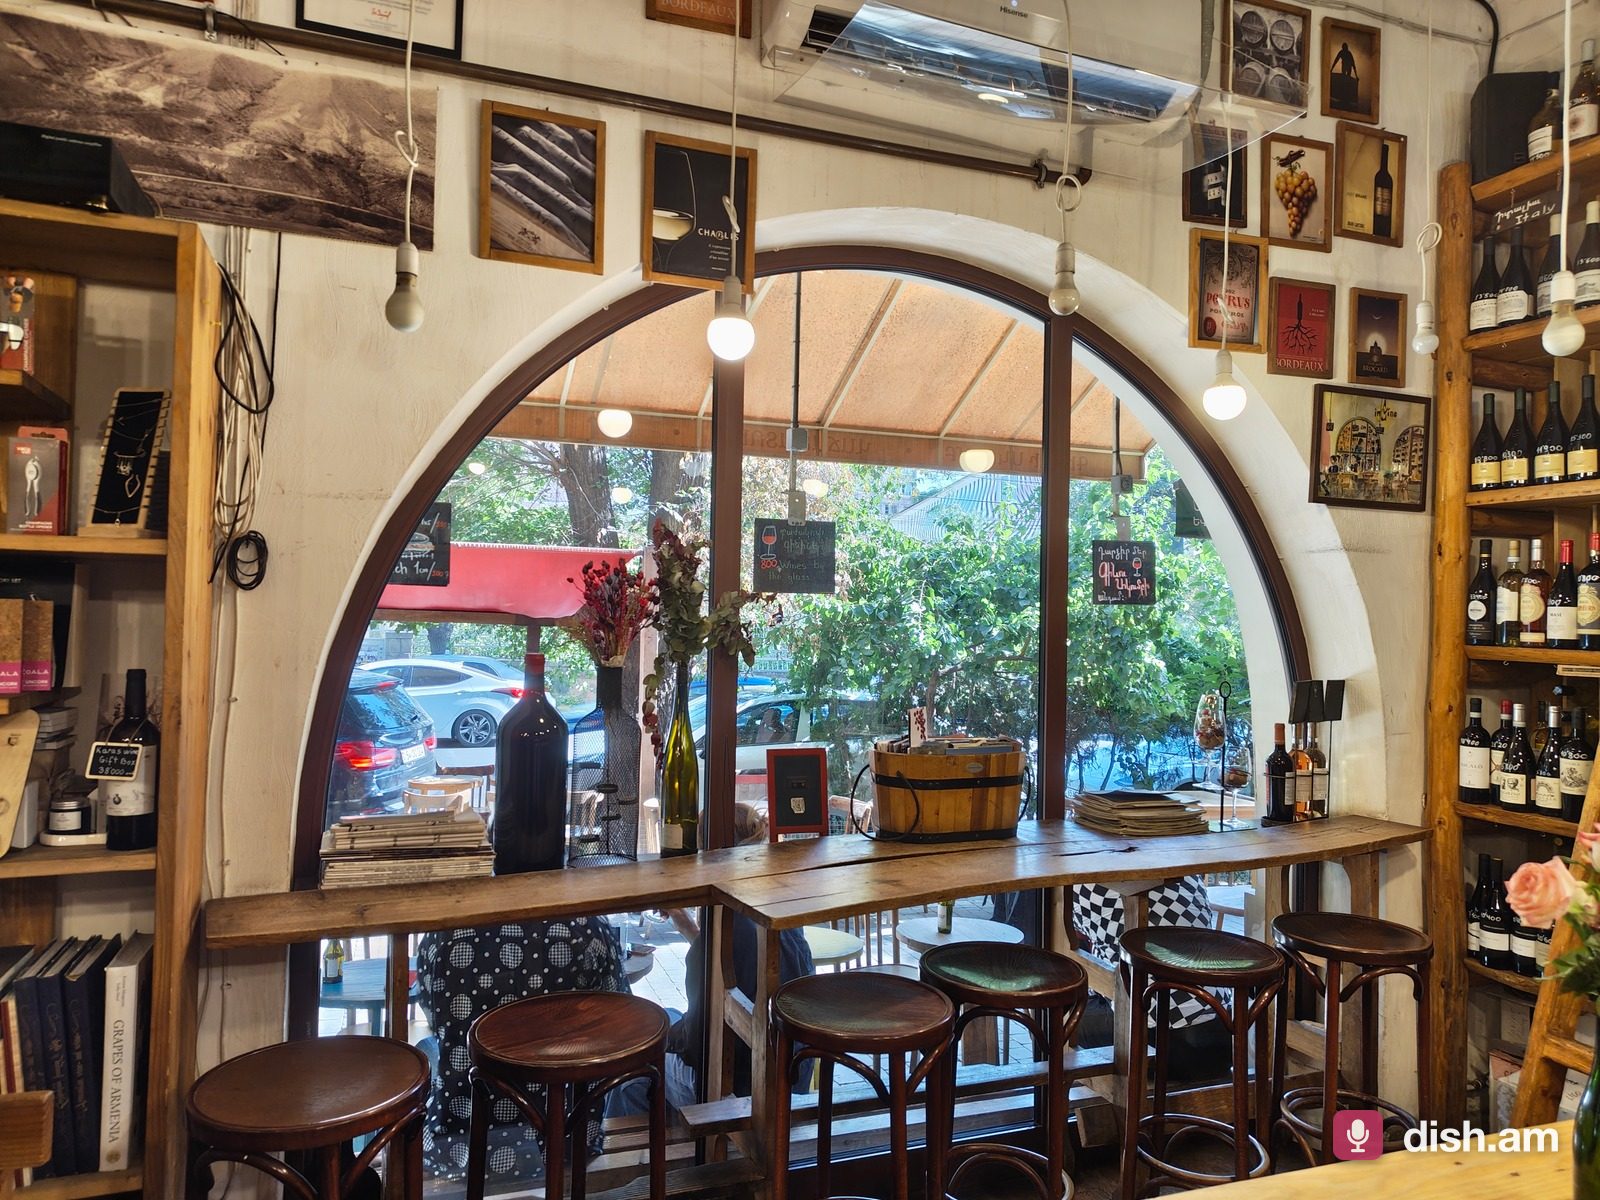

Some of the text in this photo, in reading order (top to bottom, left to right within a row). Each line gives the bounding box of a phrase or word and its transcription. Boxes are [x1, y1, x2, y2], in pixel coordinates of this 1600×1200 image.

[1000, 6, 1028, 18] Hisense
[1515, 204, 1556, 225] Italy
[1206, 292, 1250, 308] PERUS
[100, 756, 135, 765] Gift Box
[112, 1019, 125, 1065] GRAPES
[111, 1067, 123, 1084] OF
[108, 1087, 121, 1143] ARMENIA
